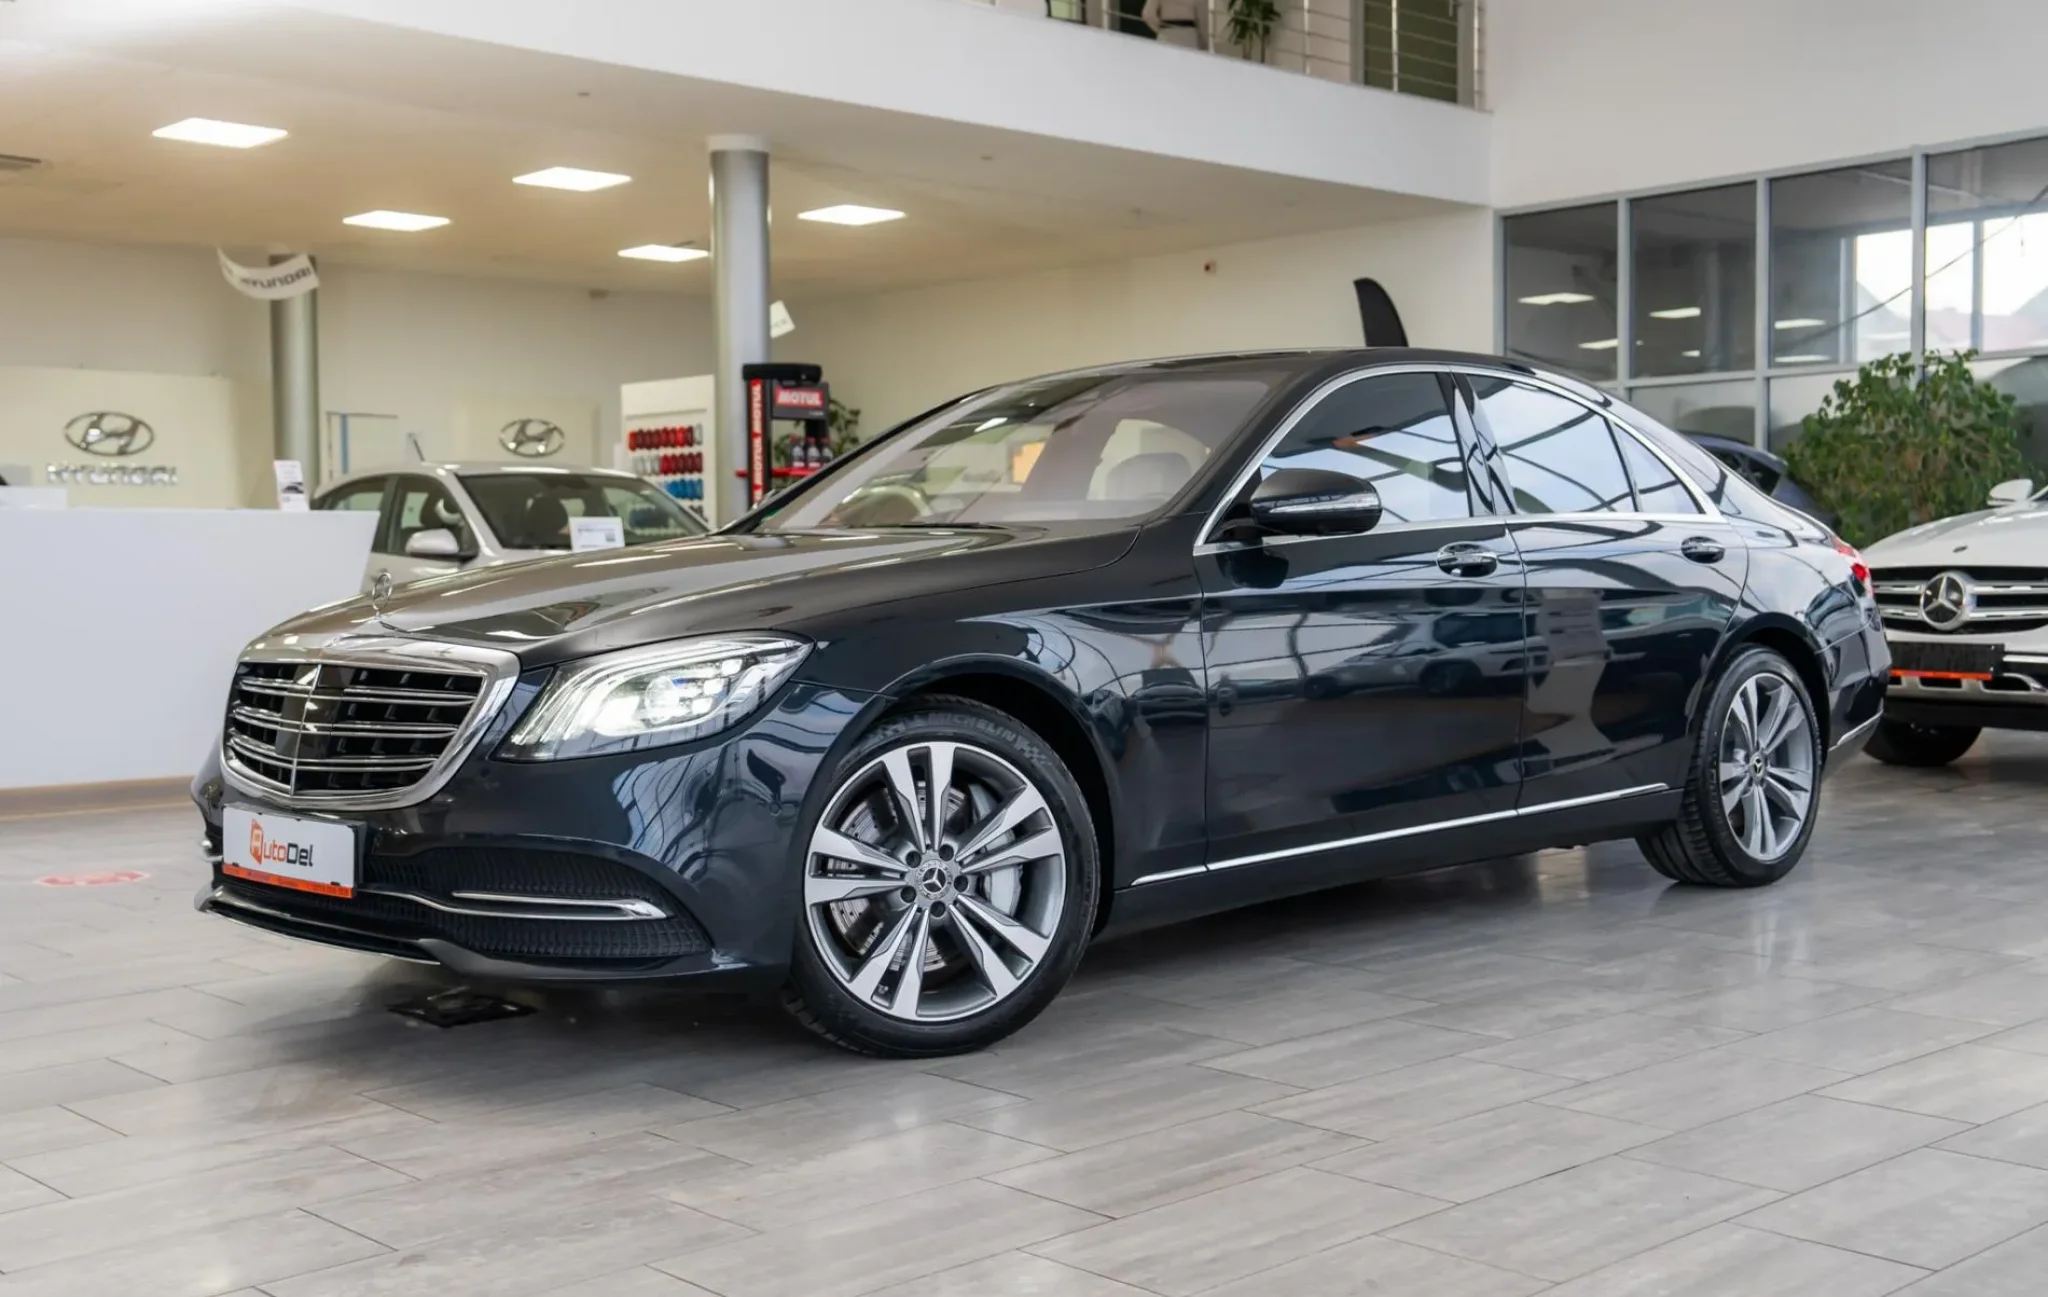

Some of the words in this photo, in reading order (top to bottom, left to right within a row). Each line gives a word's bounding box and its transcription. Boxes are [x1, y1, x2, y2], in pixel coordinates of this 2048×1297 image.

[778, 389, 822, 406] MOTUL
[46, 461, 178, 485] HYUNDAI
[928, 711, 1017, 742] MICHELIN
[249, 818, 313, 867] AutoDel
